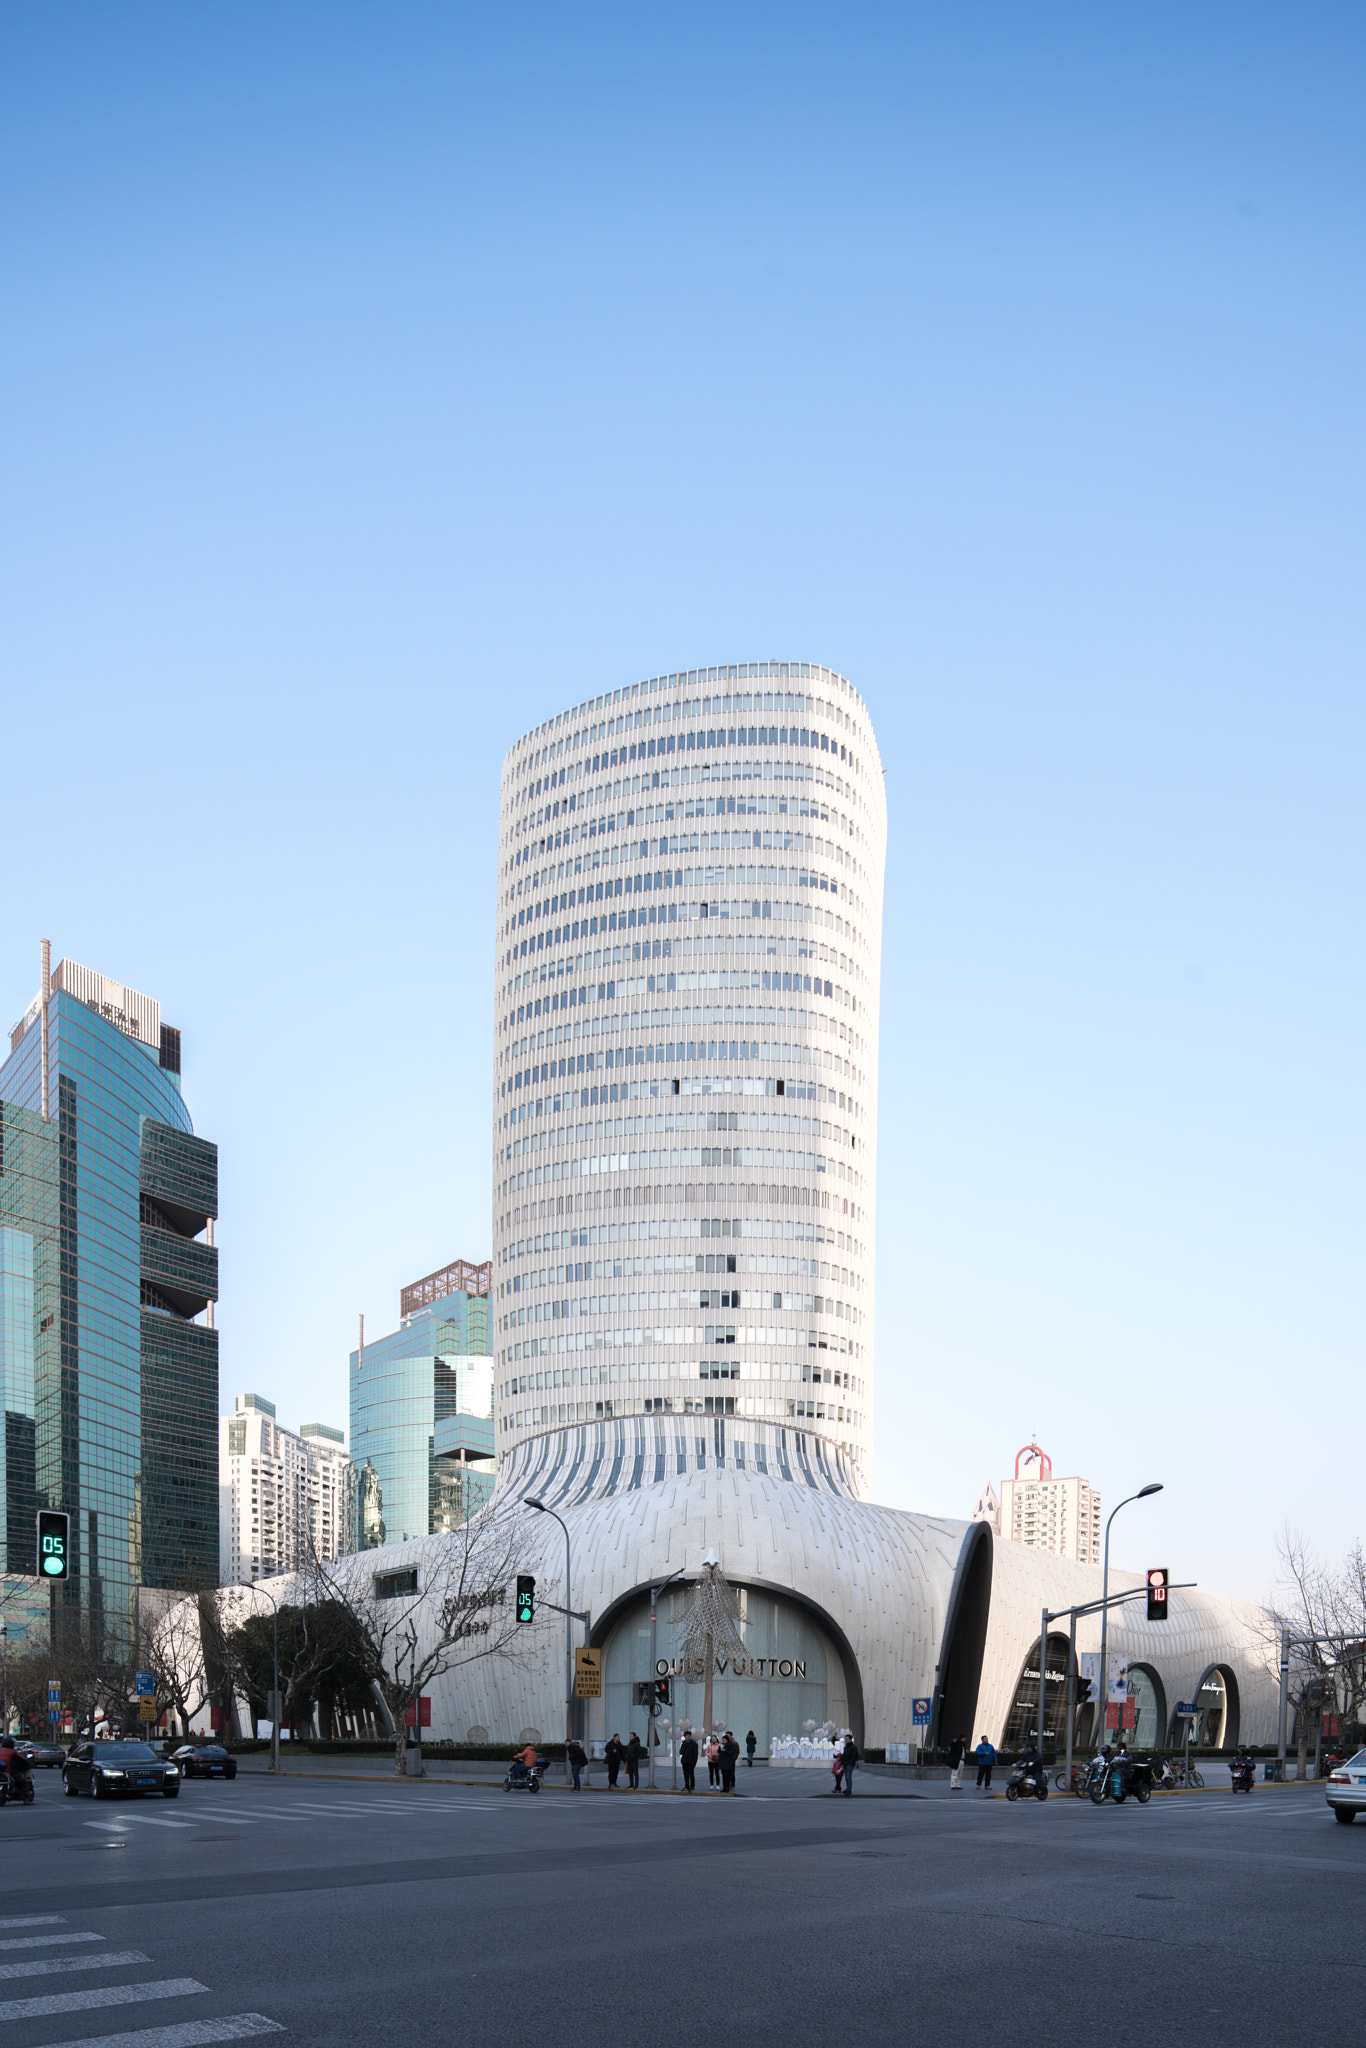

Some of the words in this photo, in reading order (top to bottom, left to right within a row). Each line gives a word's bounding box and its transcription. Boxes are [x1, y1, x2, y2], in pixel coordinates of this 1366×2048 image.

[43, 1536, 63, 1554] 05
[518, 1593, 531, 1605] 05
[1154, 1588, 1165, 1601] 10
[651, 1658, 704, 1677] OUIS
[715, 1658, 806, 1679] VUITTON
[1127, 1679, 1141, 1696] Dior
[776, 1739, 841, 1760] MOOMIN
